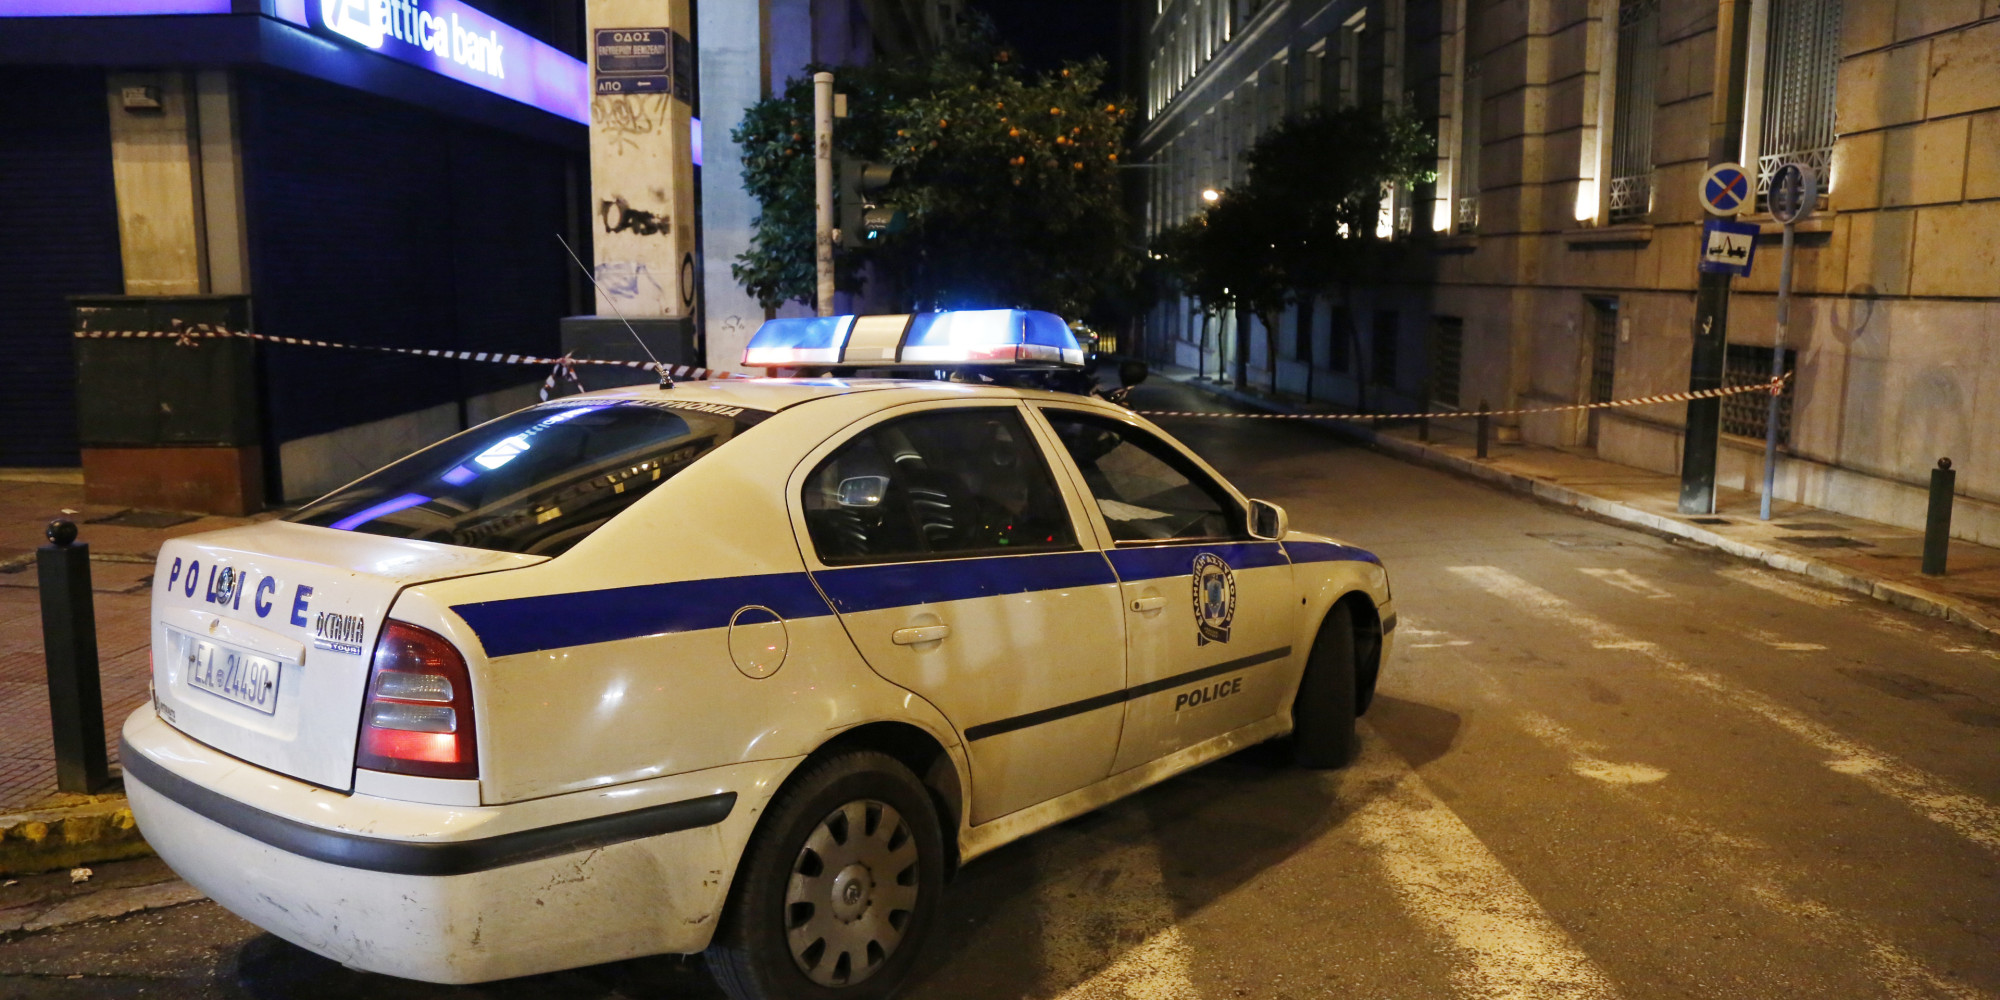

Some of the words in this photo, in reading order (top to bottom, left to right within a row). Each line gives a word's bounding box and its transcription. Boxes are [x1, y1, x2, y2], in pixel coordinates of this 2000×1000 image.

[380, 0, 449, 58] attica
[452, 12, 504, 79] bank
[613, 32, 650, 42] ΟΔΟΣ
[599, 82, 621, 91] ΑΠΟ
[168, 557, 313, 627] POLICE
[316, 611, 364, 643] OCTAVIA
[333, 644, 358, 654] TOUR
[224, 654, 269, 705] 24490
[1175, 678, 1243, 712] POLICE
